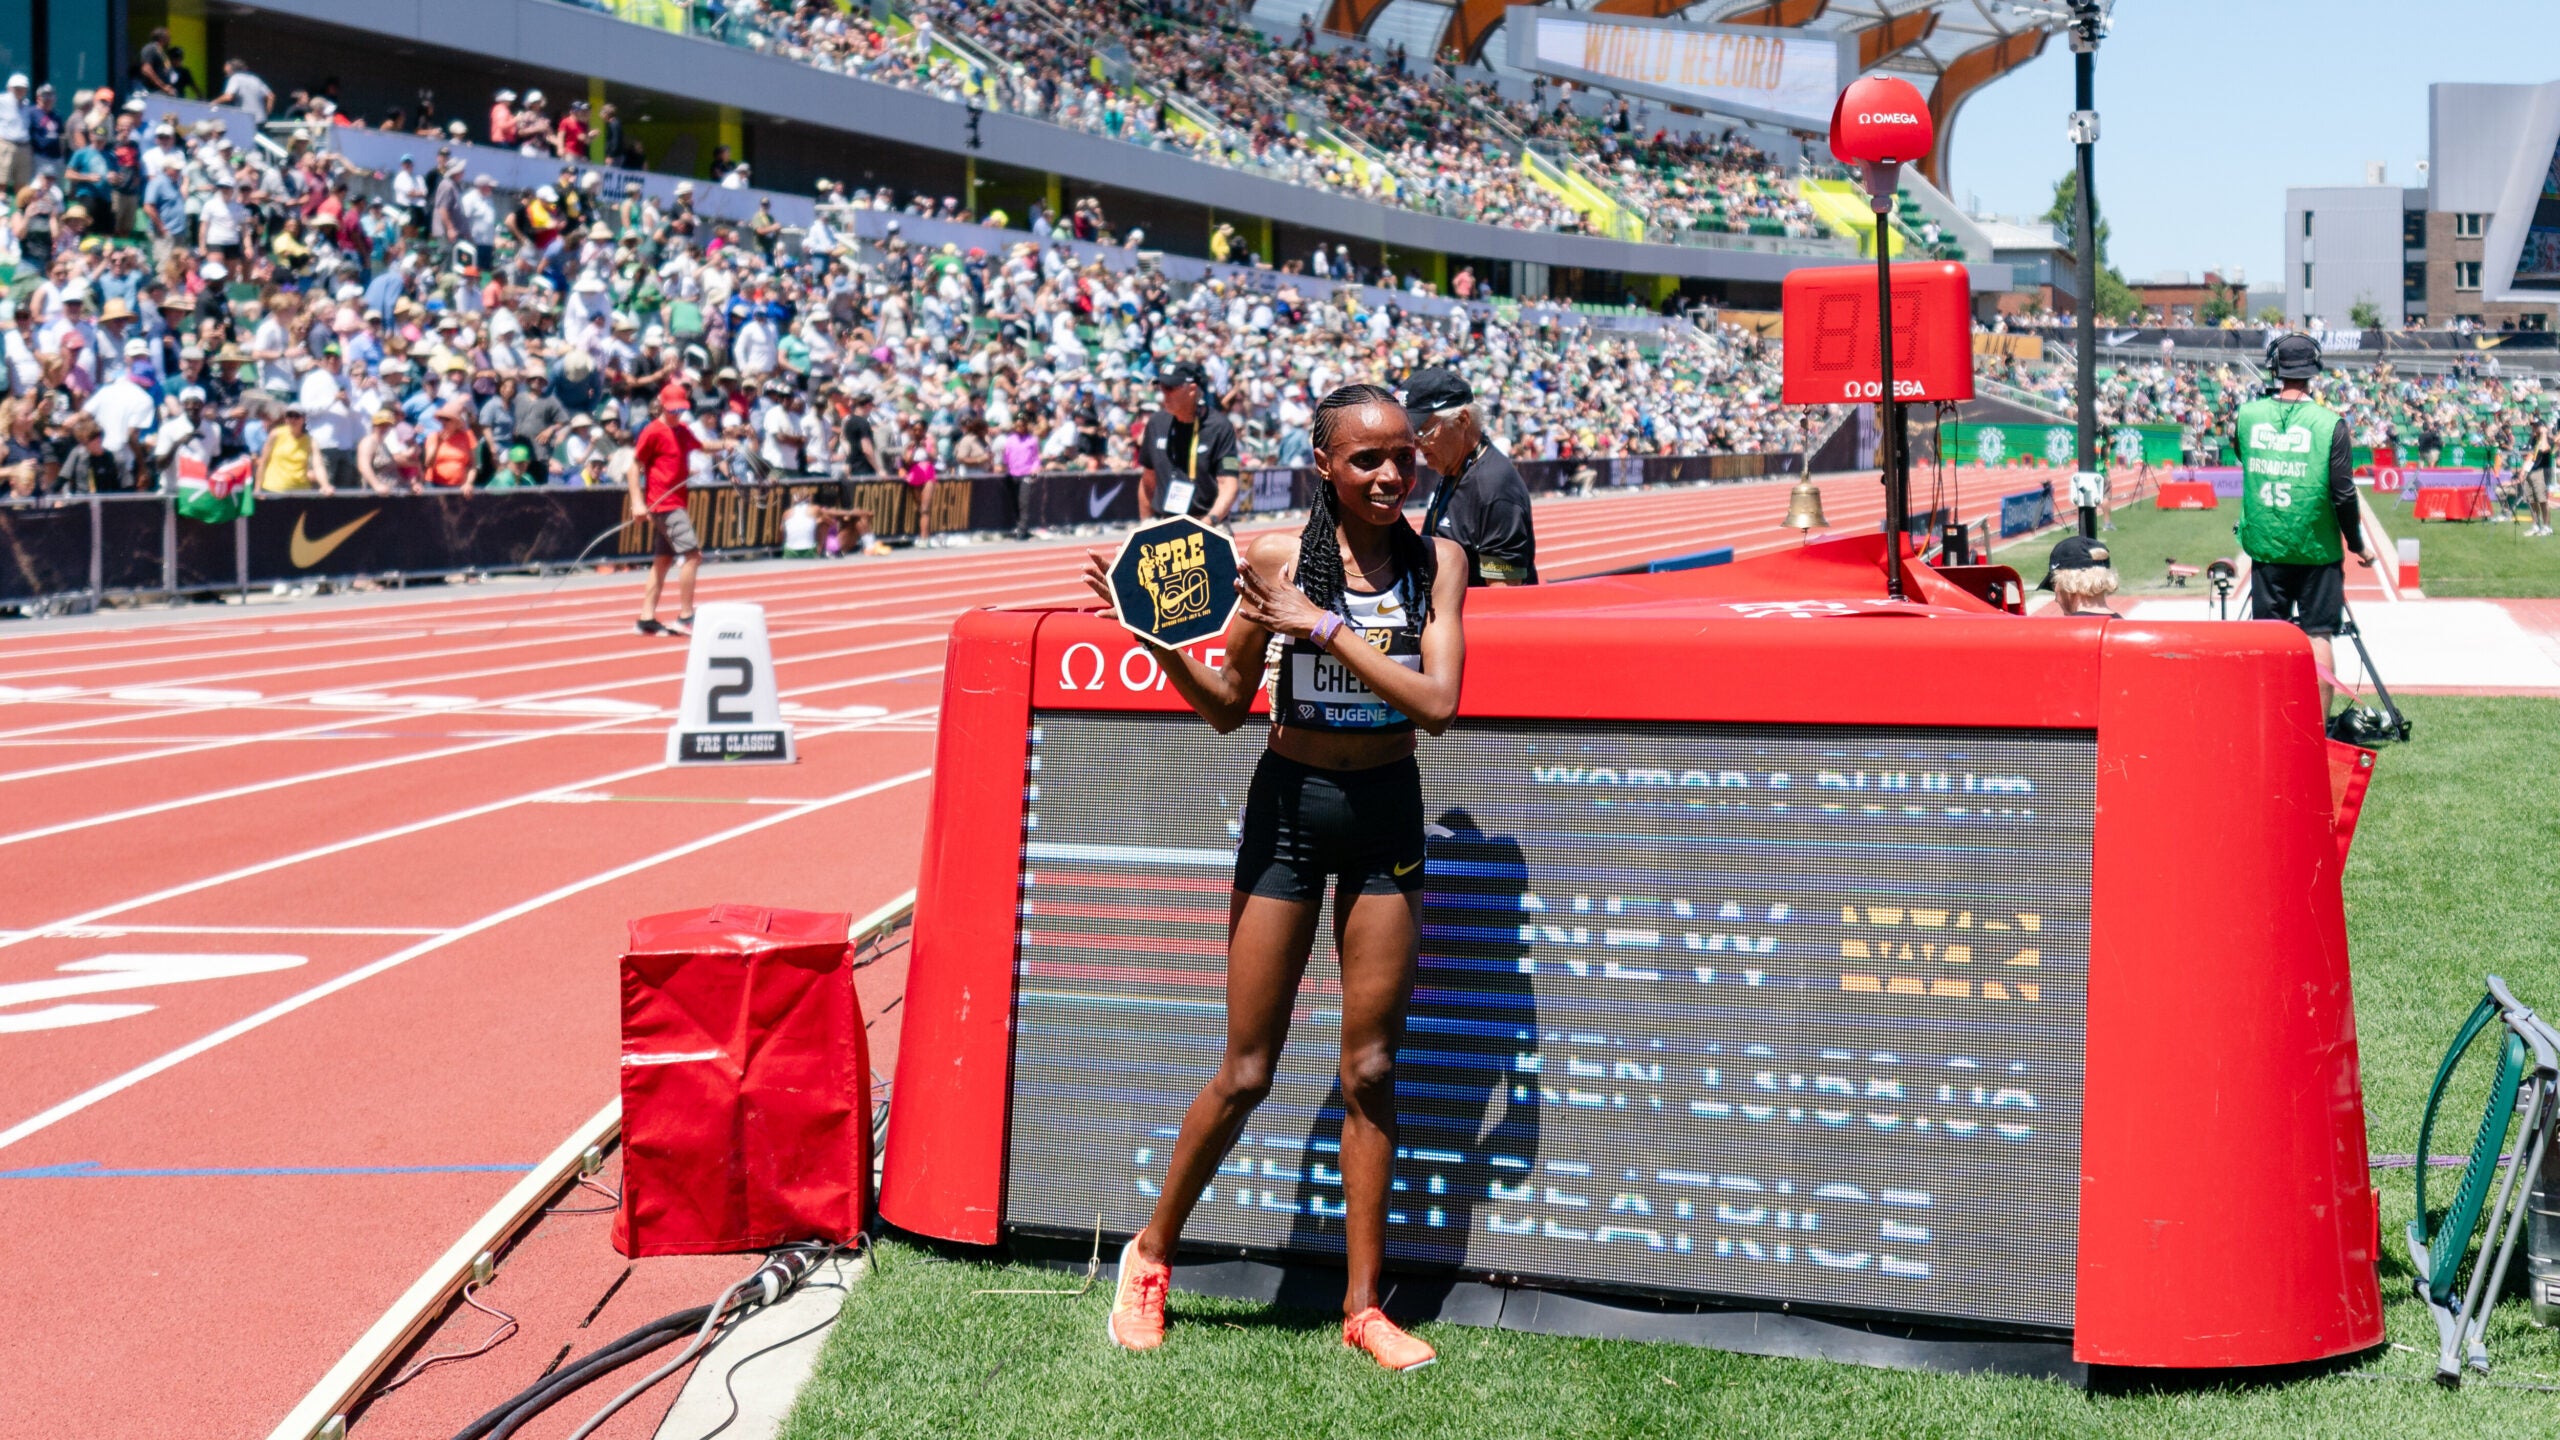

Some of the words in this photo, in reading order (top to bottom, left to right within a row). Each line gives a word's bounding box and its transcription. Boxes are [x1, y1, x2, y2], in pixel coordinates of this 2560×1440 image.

[1583, 22, 1674, 83] WORLD
[1680, 31, 1786, 91] RECORD
[1873, 112, 1918, 125] OMEGA
[1864, 379, 1926, 397] OEGA
[2248, 457, 2309, 478] BROADCAST
[2259, 481, 2293, 508] 45
[1155, 532, 1206, 578] PRE
[1160, 566, 1211, 620] 50
[707, 656, 754, 725] 2
[1325, 707, 1388, 722] EUGENE
[695, 734, 722, 753] PRE
[725, 733, 777, 753] CLASSIC
[1517, 892, 1792, 987] NEW
[1513, 1029, 1664, 1112] KEN
[1134, 1128, 1465, 1228] CHEBT
[1488, 1155, 1932, 1280] BEATRICE
